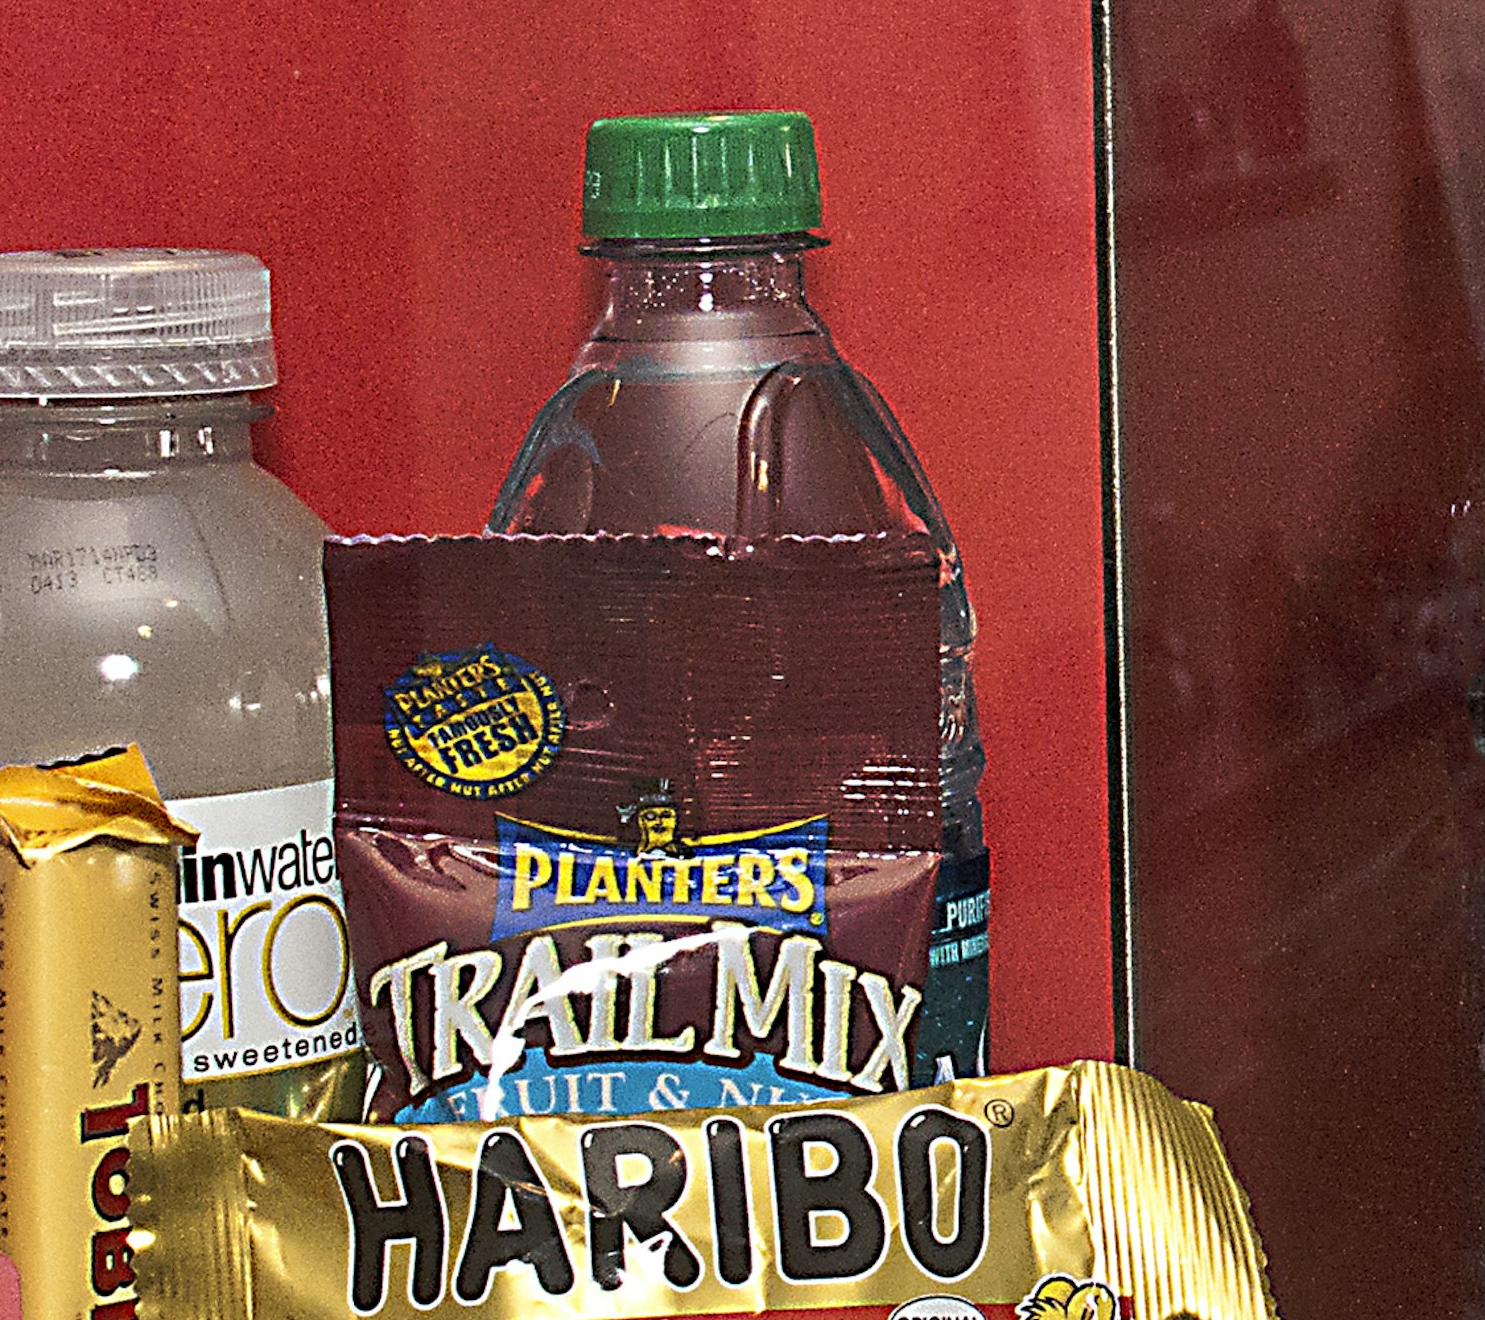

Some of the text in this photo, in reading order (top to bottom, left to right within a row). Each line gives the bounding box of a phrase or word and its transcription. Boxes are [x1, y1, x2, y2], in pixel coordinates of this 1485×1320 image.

[438, 713, 539, 774] FRESH
[450, 782, 481, 797] NUT
[512, 844, 817, 912] PLANTERS
[946, 890, 991, 930] PURIF
[178, 893, 350, 1042] ero
[370, 921, 923, 1096] TRAIL MIX
[193, 1022, 357, 1072] sweetened
[647, 1073, 691, 1111] &
[329, 1104, 992, 1316] HARIBO
